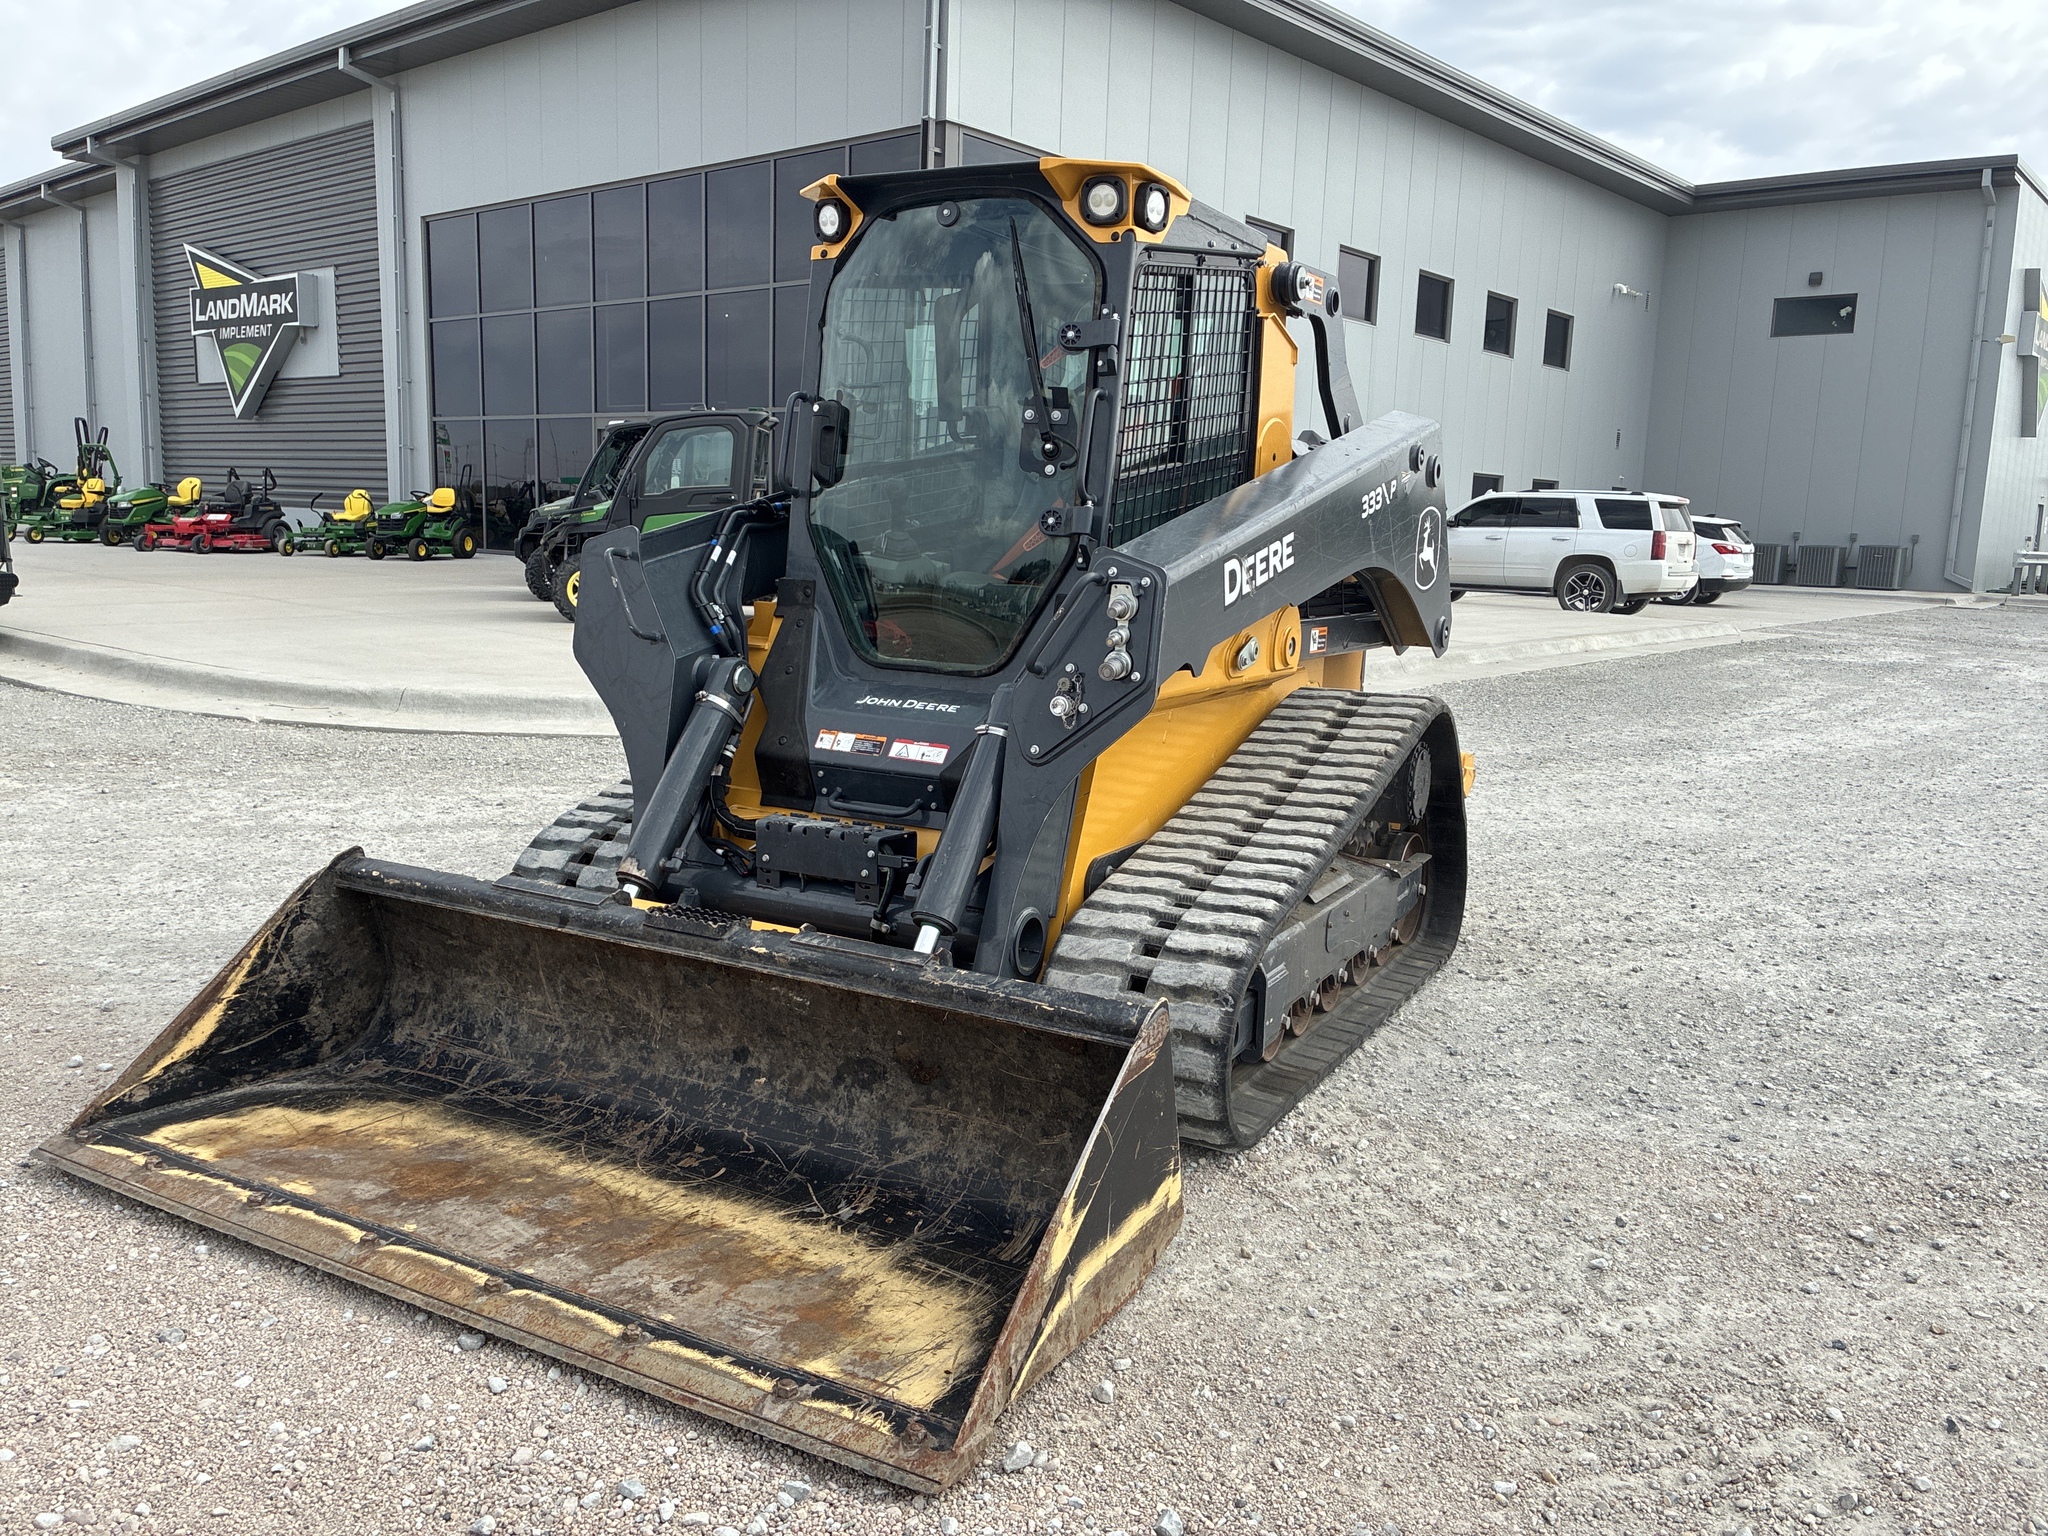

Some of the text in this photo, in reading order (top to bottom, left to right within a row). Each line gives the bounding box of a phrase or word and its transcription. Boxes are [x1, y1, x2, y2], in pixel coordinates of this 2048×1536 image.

[195, 292, 294, 322] LANDMARK
[219, 323, 273, 340] IMPLEMENT
[1224, 531, 1295, 607] DEERE
[855, 695, 961, 713] JOHN DEERE
